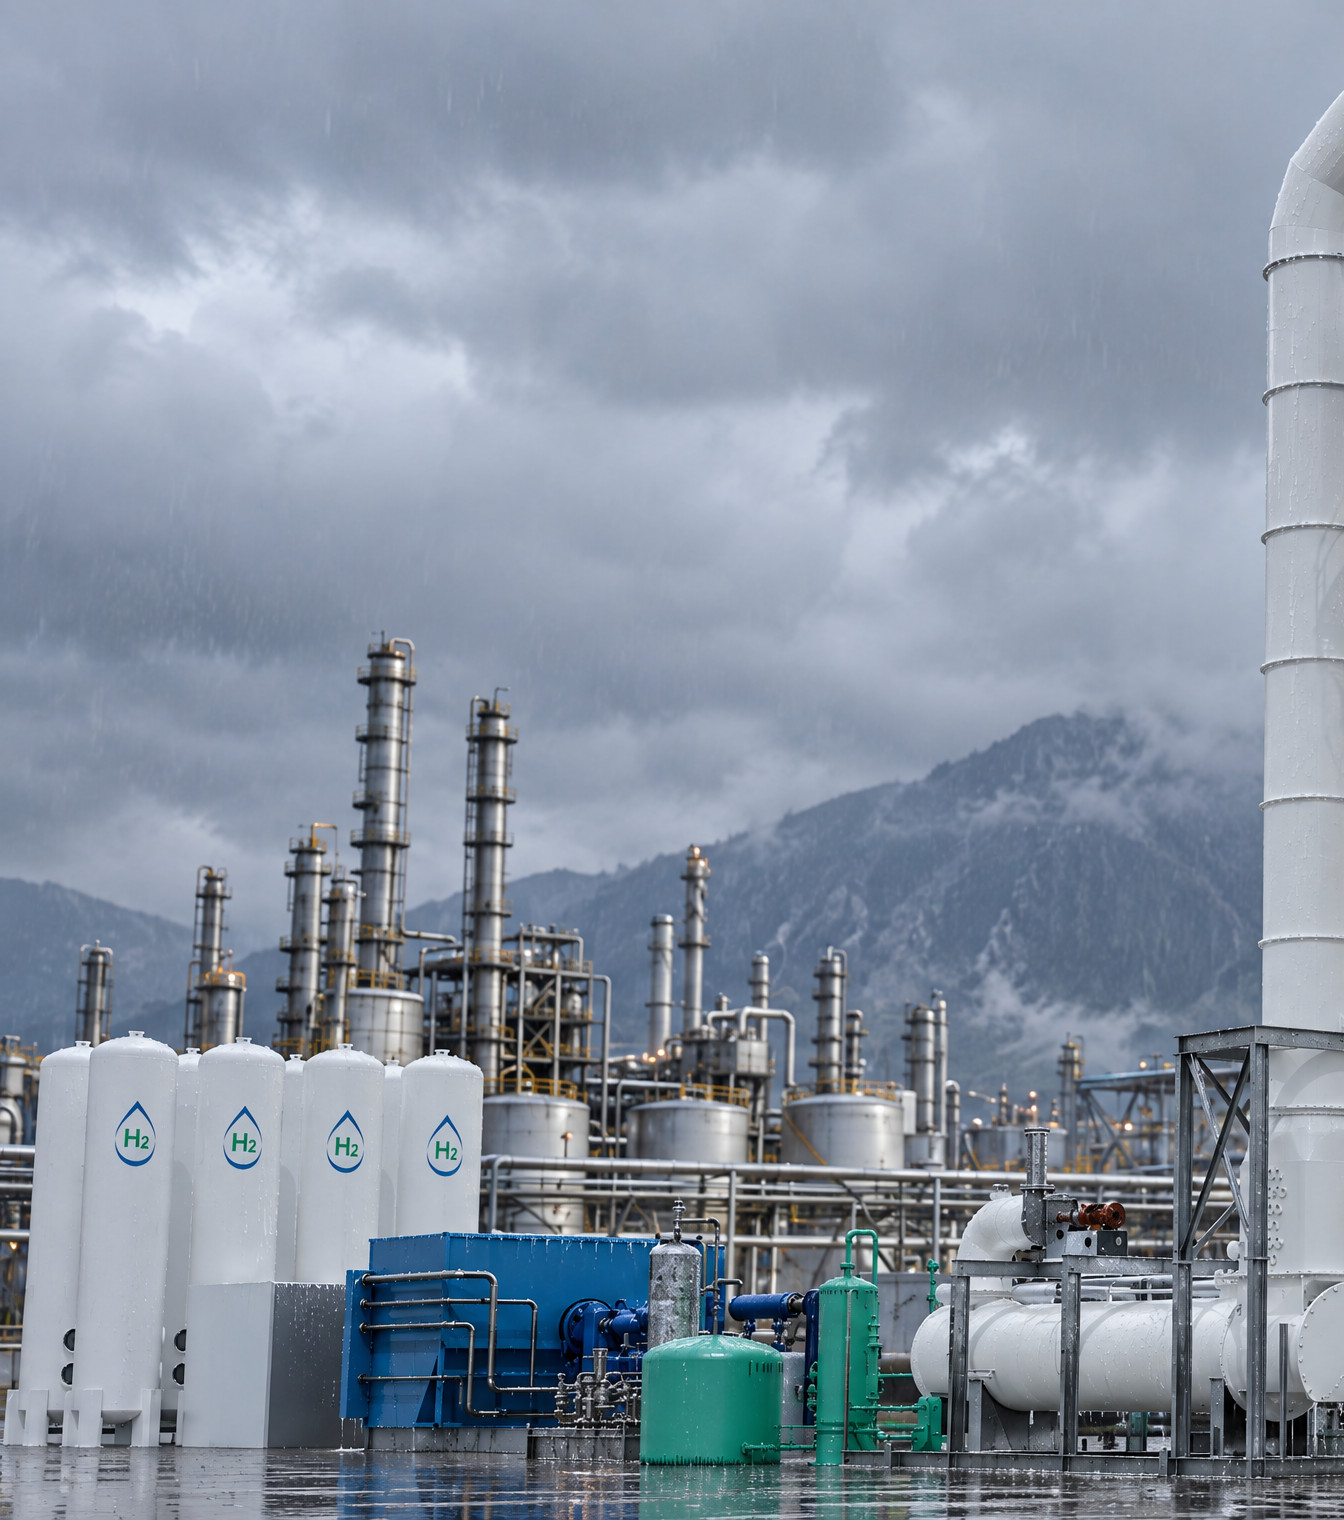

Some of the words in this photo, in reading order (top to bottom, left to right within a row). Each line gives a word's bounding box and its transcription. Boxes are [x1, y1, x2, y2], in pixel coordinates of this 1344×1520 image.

[123, 1128, 150, 1150] H2
[231, 1133, 257, 1153] H2
[335, 1136, 359, 1157] H2
[435, 1140, 458, 1160] H2
